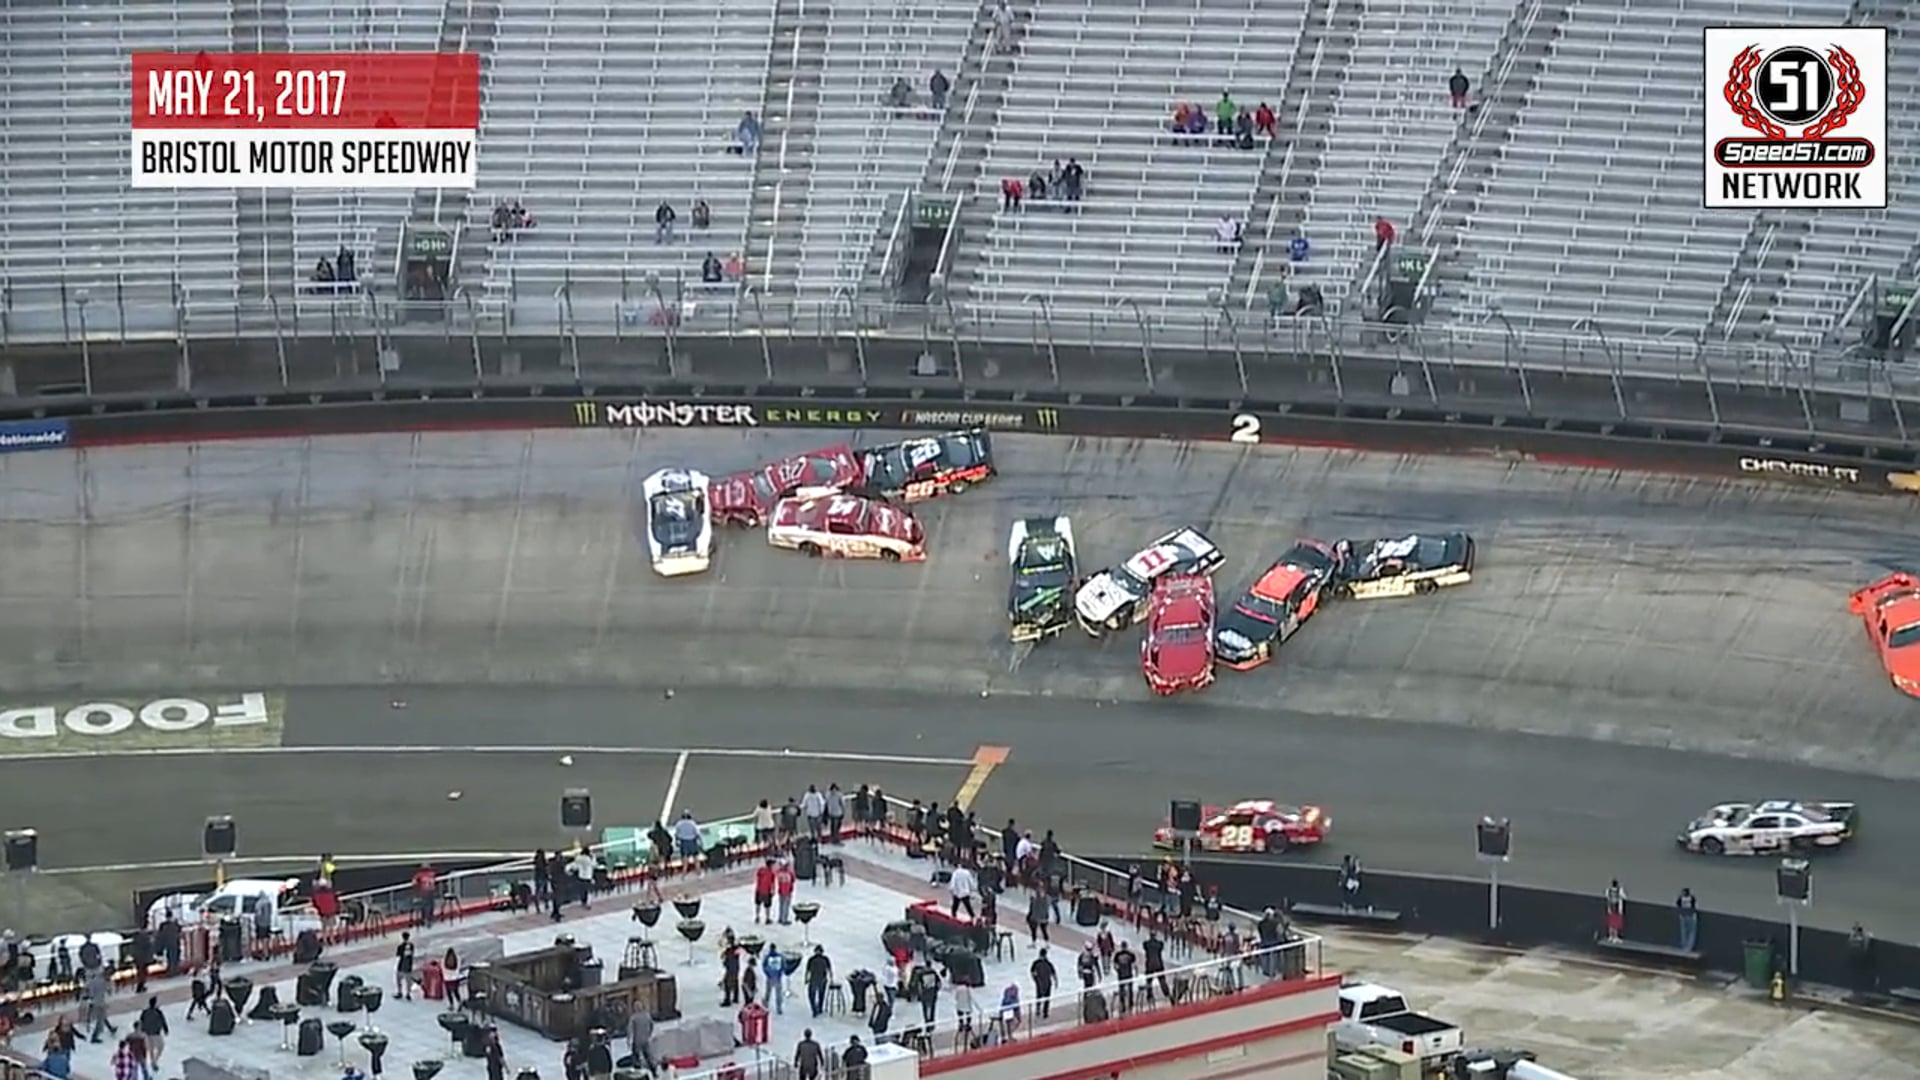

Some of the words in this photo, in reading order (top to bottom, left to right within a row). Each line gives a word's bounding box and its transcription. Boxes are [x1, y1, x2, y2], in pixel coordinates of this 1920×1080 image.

[605, 400, 759, 427] MONSTER
[765, 409, 882, 423] ENERGY
[1230, 412, 1261, 444] 2
[1137, 549, 1170, 572] 11
[0, 692, 269, 738] FOOD
[1220, 824, 1253, 847] 28
